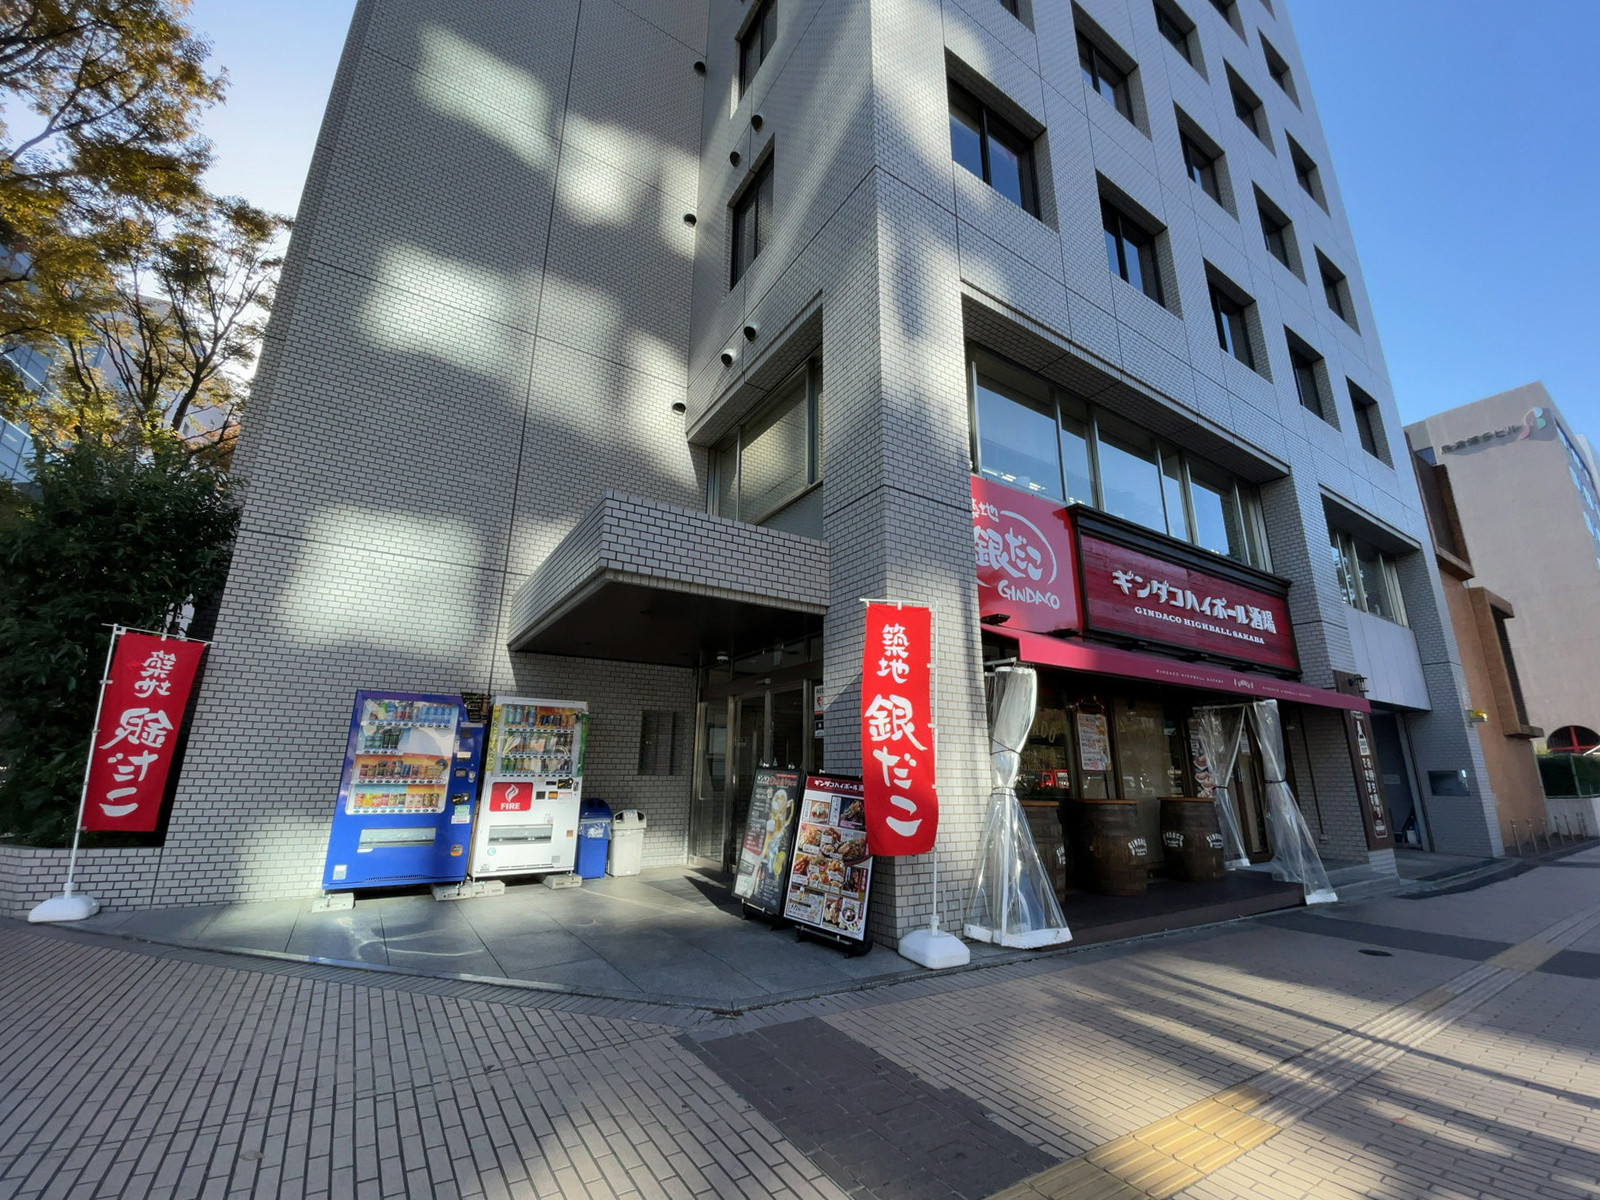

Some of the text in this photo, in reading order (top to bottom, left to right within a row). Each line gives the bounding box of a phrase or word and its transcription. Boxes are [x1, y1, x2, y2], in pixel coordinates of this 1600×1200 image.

[974, 525, 1043, 581] 銀だこ
[997, 579, 1061, 609] GINDACO
[1111, 569, 1277, 634] ギンダコハイボール酒場
[1134, 606, 1265, 645] GINDACO HIGHBALL SAKABA
[500, 802, 521, 810] FIRE
